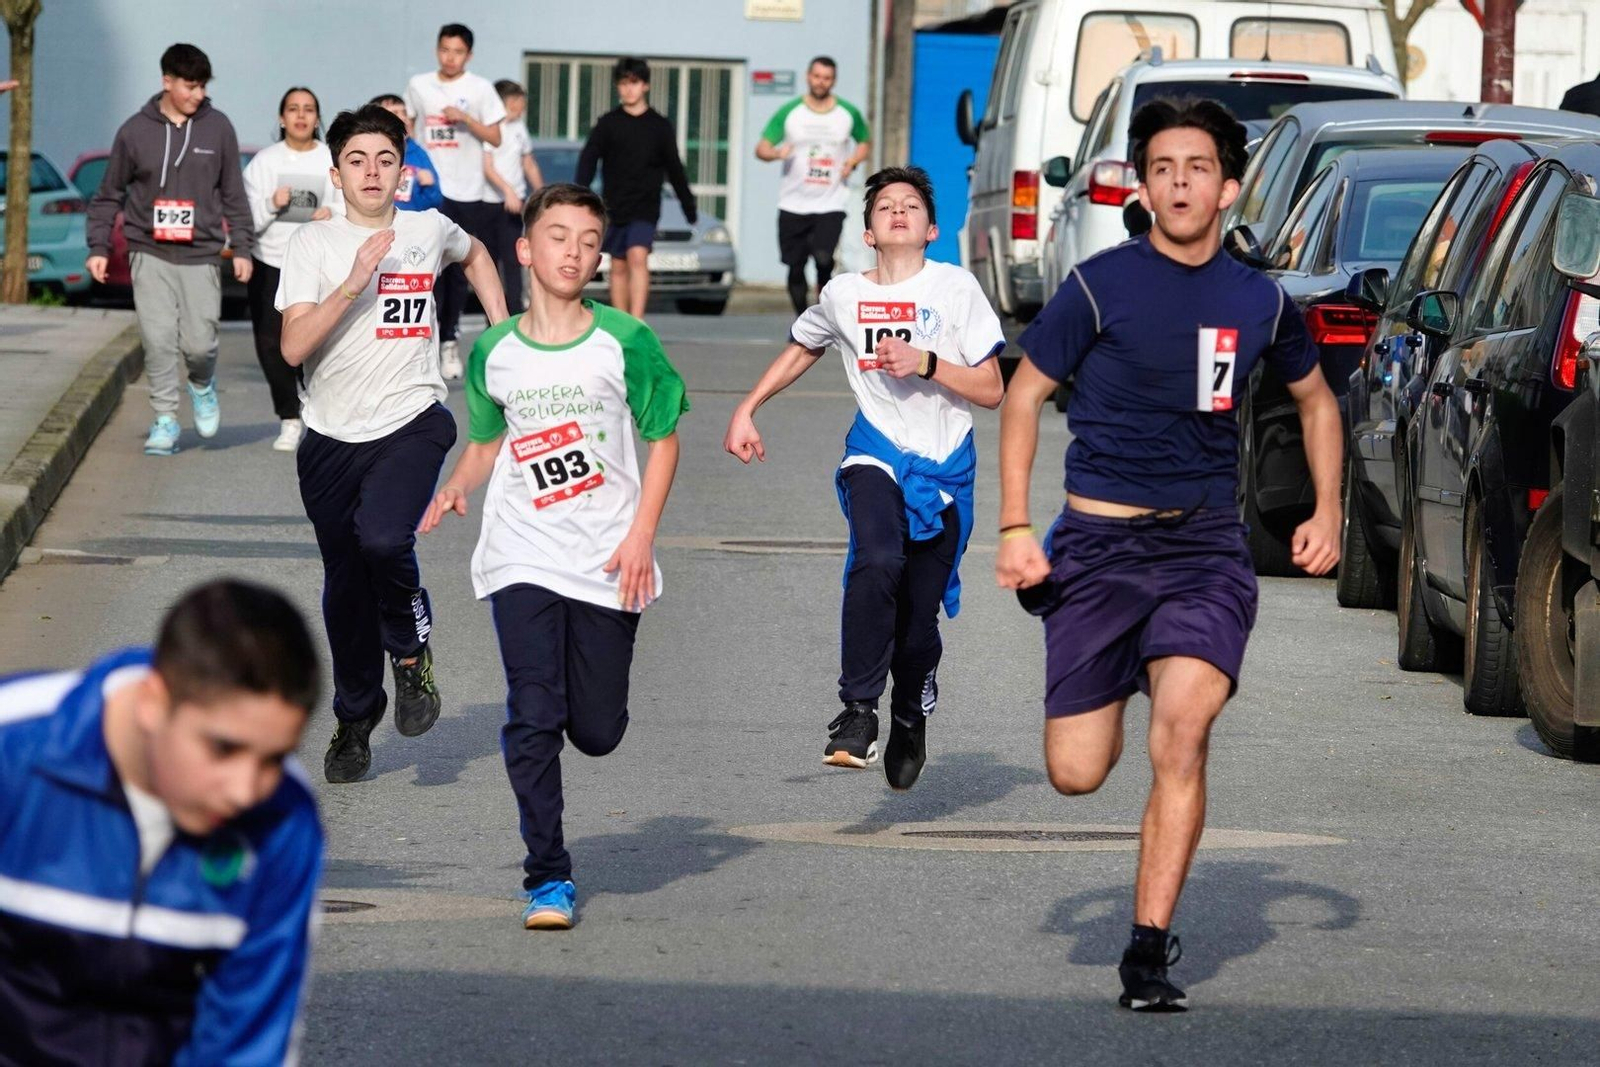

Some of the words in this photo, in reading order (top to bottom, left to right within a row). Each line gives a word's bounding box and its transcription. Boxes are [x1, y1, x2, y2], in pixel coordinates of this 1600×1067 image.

[157, 209, 191, 225] 244
[380, 276, 406, 285] Carrera
[382, 298, 427, 324] 217
[506, 384, 585, 405] CARRERA
[518, 401, 604, 420] SOLIDARIA
[529, 449, 590, 491] 193
